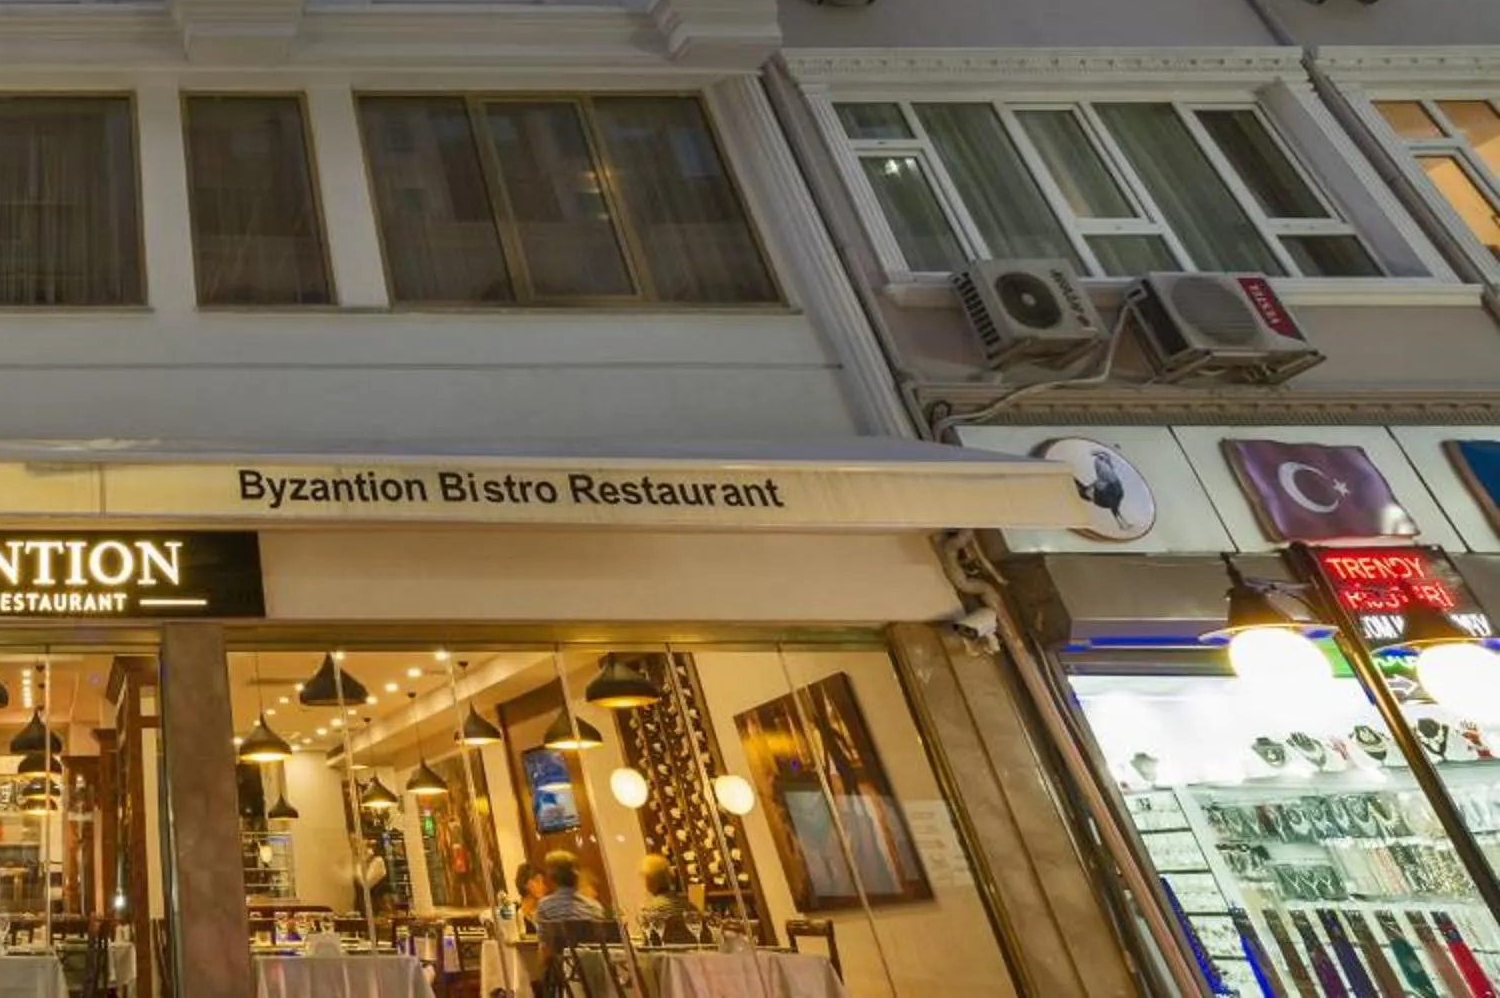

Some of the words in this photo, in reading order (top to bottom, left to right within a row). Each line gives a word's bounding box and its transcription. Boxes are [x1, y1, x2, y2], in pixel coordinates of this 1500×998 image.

[238, 469, 428, 508] Byzantion
[438, 471, 558, 505] Bistro
[568, 473, 785, 508] Restaurant
[1324, 556, 1426, 580] TRENDY
